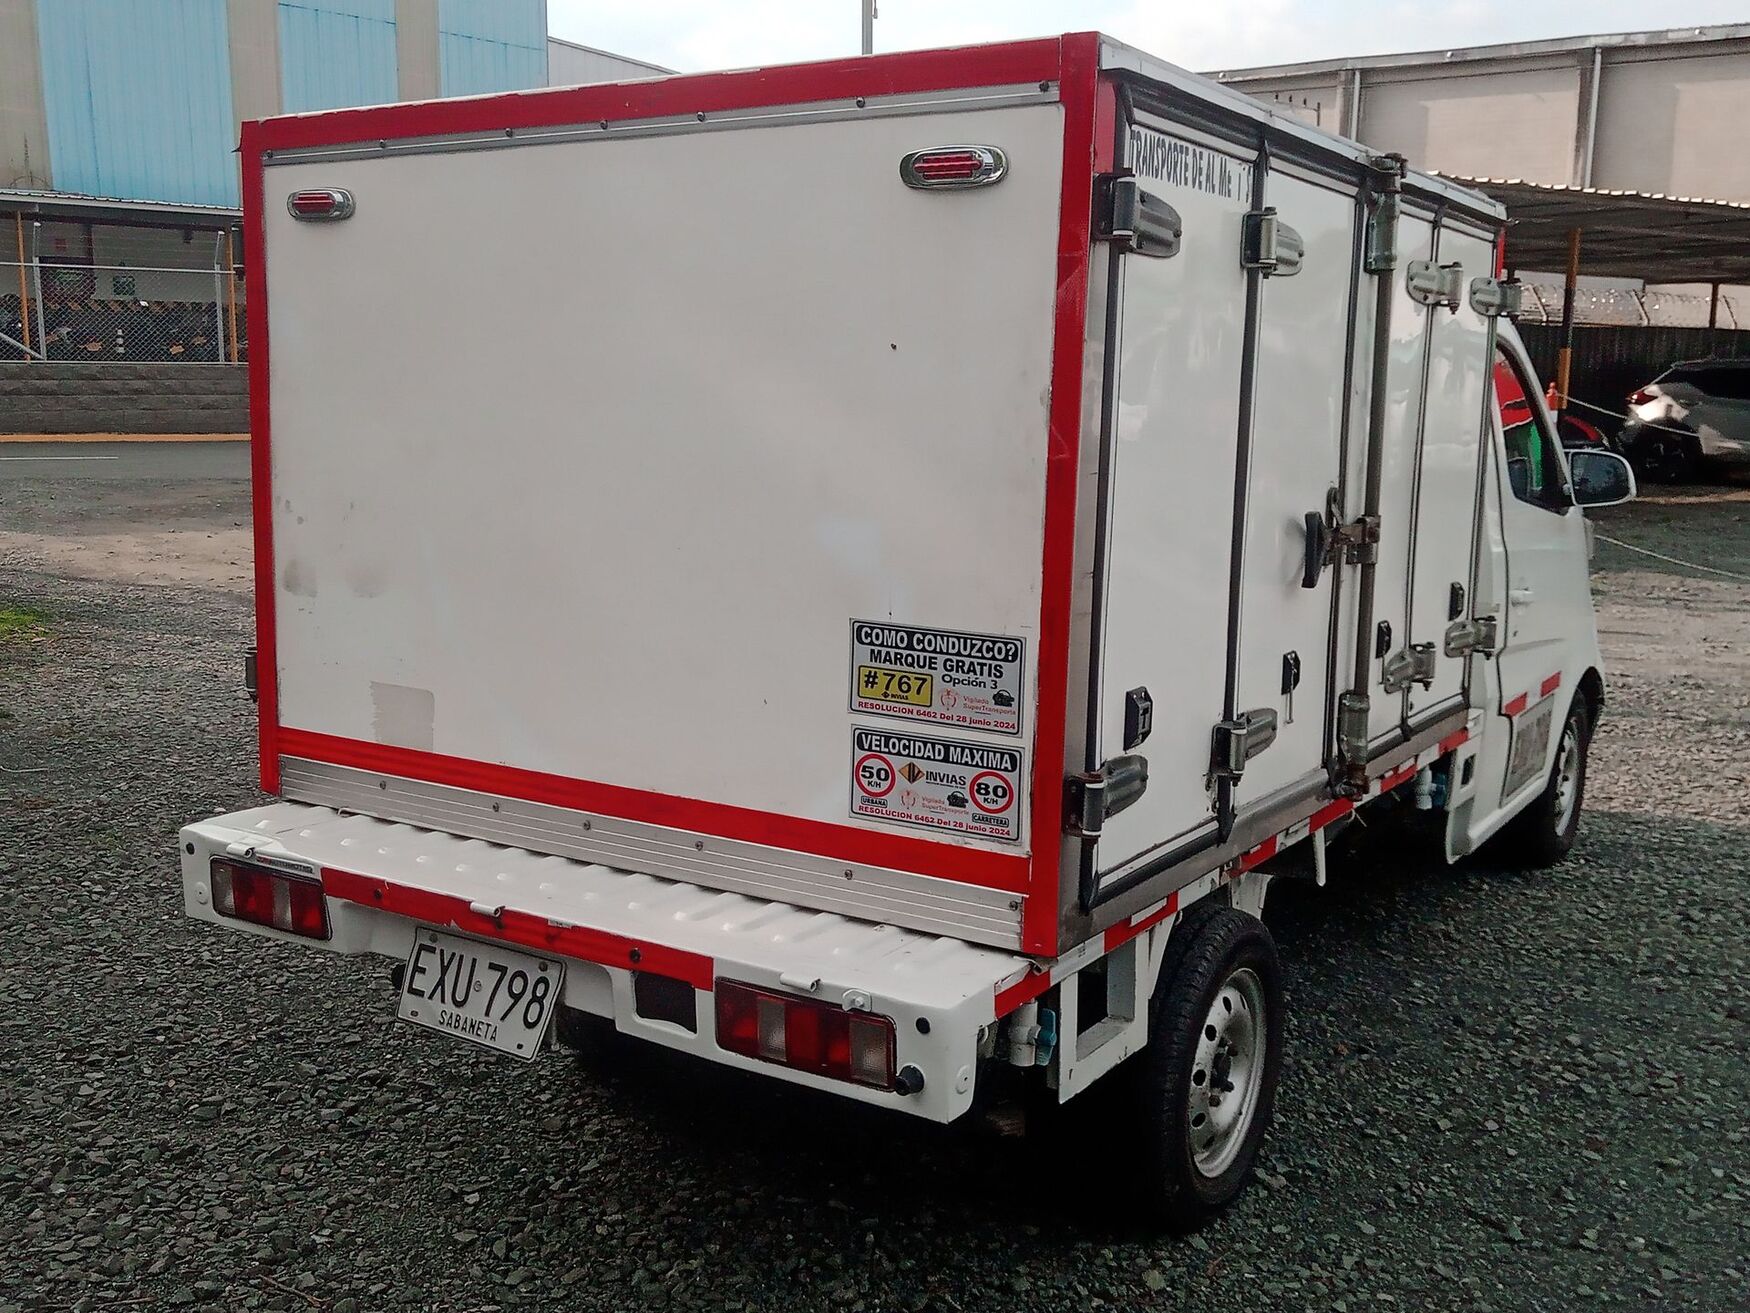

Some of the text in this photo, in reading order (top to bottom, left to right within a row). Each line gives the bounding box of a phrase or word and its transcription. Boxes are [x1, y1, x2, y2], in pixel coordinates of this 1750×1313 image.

[1131, 130, 1189, 187] TRANSPORTE
[1192, 148, 1203, 191] DE
[861, 627, 1016, 661] COMO CONDUZCO?
[869, 649, 1004, 679] MARQUE GRATIS
[864, 670, 928, 696] #767
[941, 673, 998, 690] Opción 3
[858, 701, 1016, 730] RESOLUCION 6462 Del 28 junio 2024
[861, 733, 1012, 771] VELOCIDAD MAXIMA
[860, 765, 890, 781] 50
[867, 780, 881, 789] K/H
[926, 771, 967, 786] INVIAS
[975, 782, 1008, 799] 80
[983, 797, 998, 806] K/H
[858, 805, 1011, 837] RESOLUCION 6462 Del 28 junio 2024
[407, 943, 550, 1029] EXU 798
[439, 1010, 498, 1041] SABANETA
